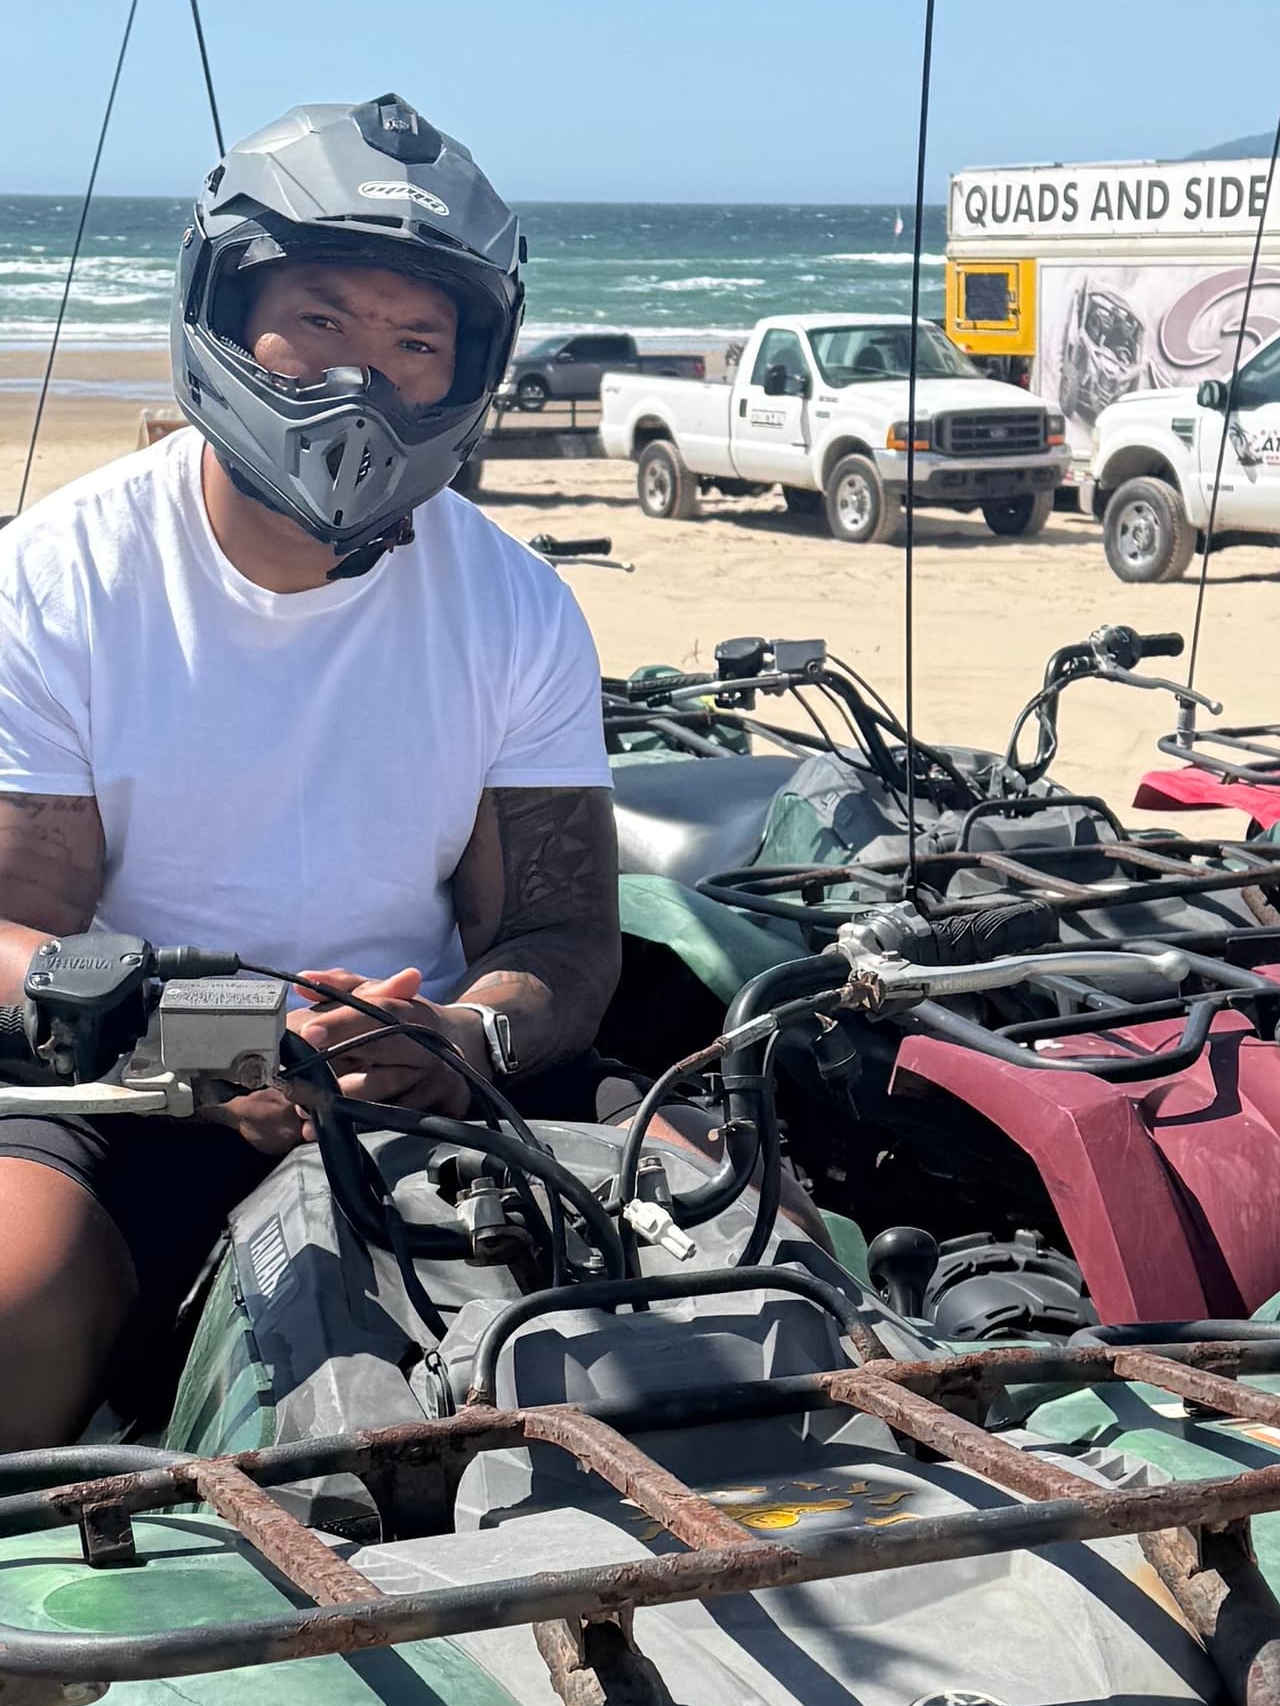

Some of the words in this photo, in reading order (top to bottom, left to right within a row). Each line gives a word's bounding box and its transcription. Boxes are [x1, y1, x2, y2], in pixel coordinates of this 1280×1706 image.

[964, 181, 1079, 228] QUADS
[1090, 179, 1170, 222] AND
[1183, 174, 1268, 220] SIDE
